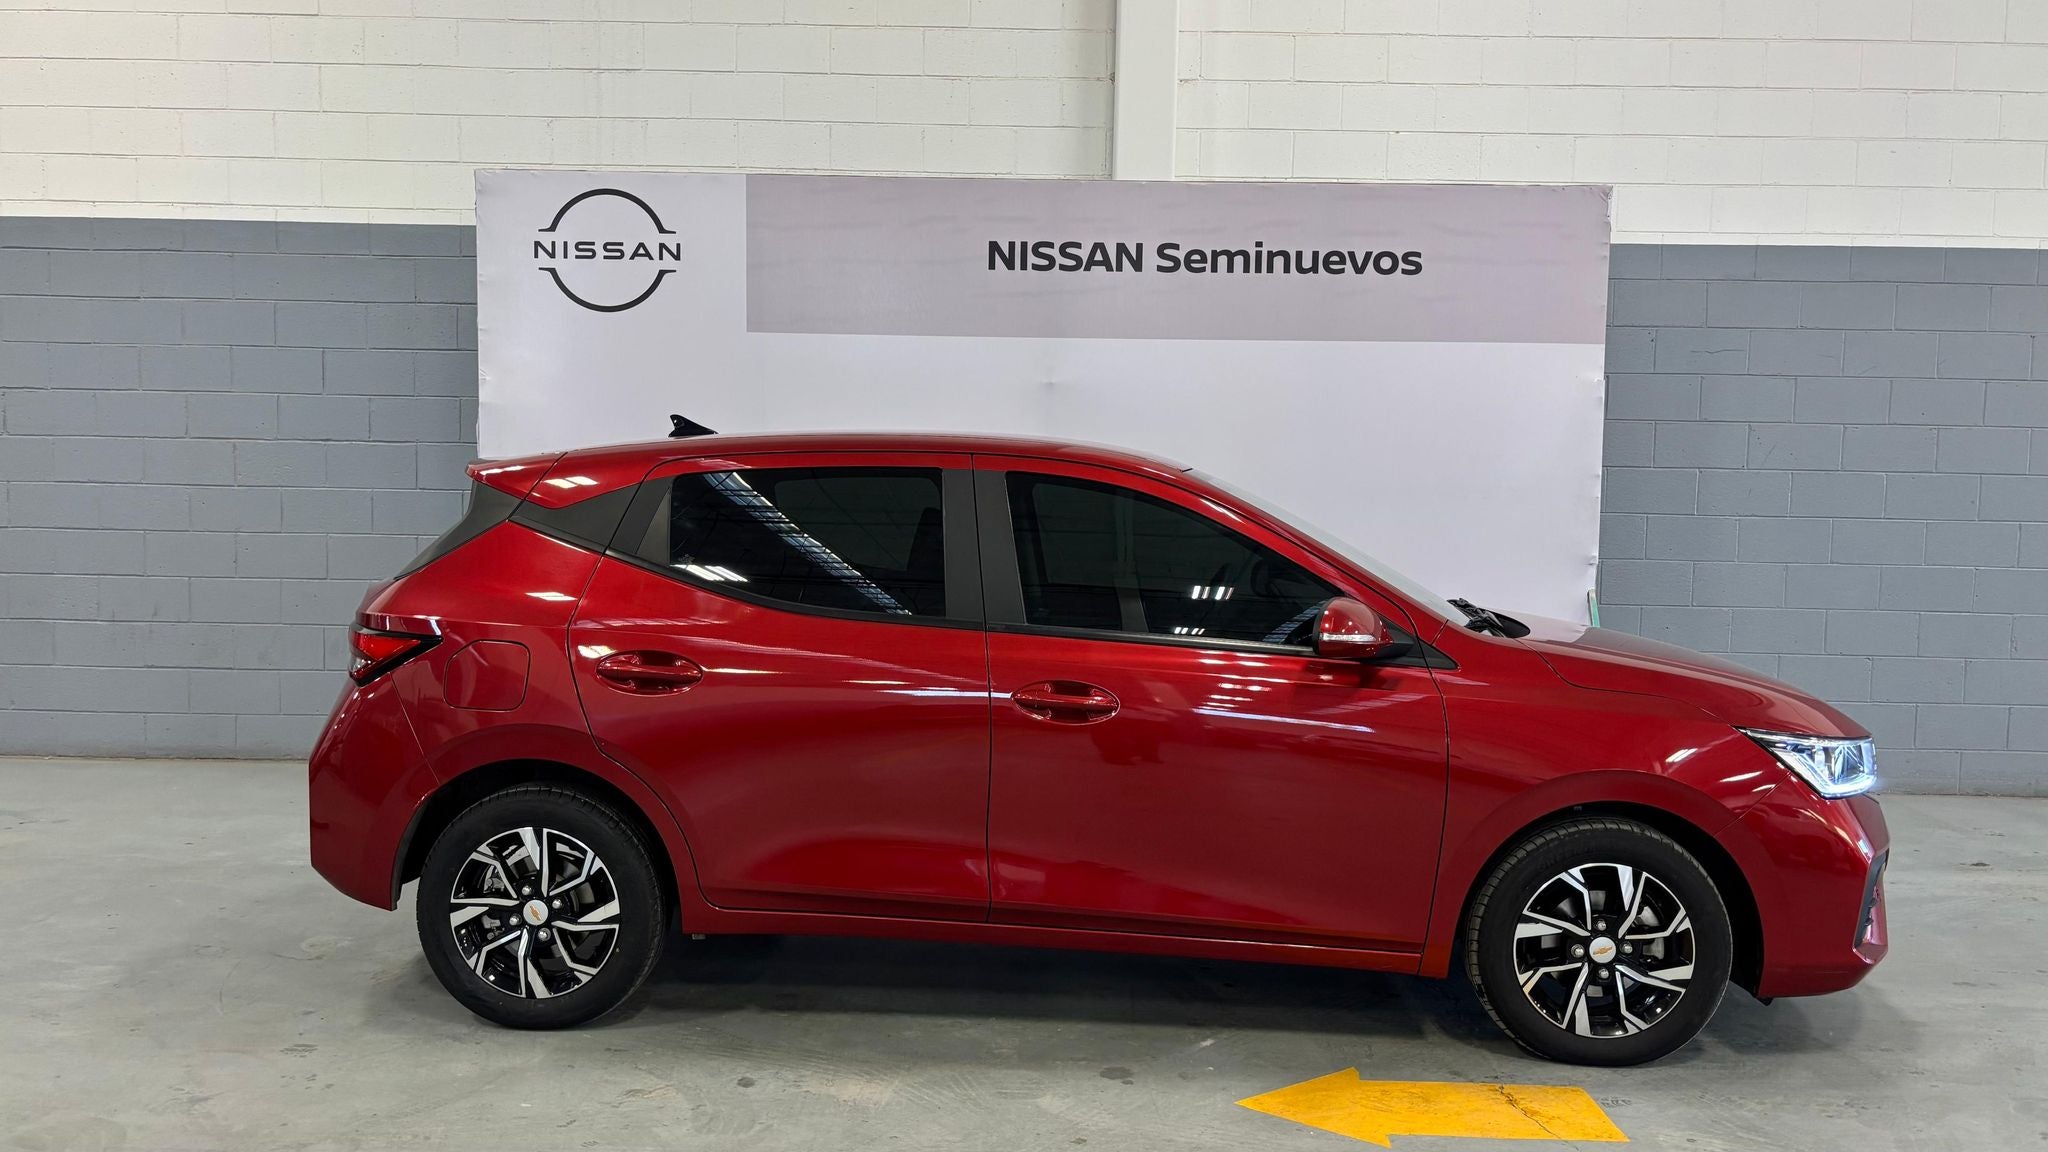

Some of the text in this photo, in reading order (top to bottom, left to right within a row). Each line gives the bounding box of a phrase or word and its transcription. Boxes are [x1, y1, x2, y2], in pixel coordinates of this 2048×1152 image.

[533, 240, 681, 261] NISSAN
[987, 240, 1423, 276] NISSAN Seminuevos
